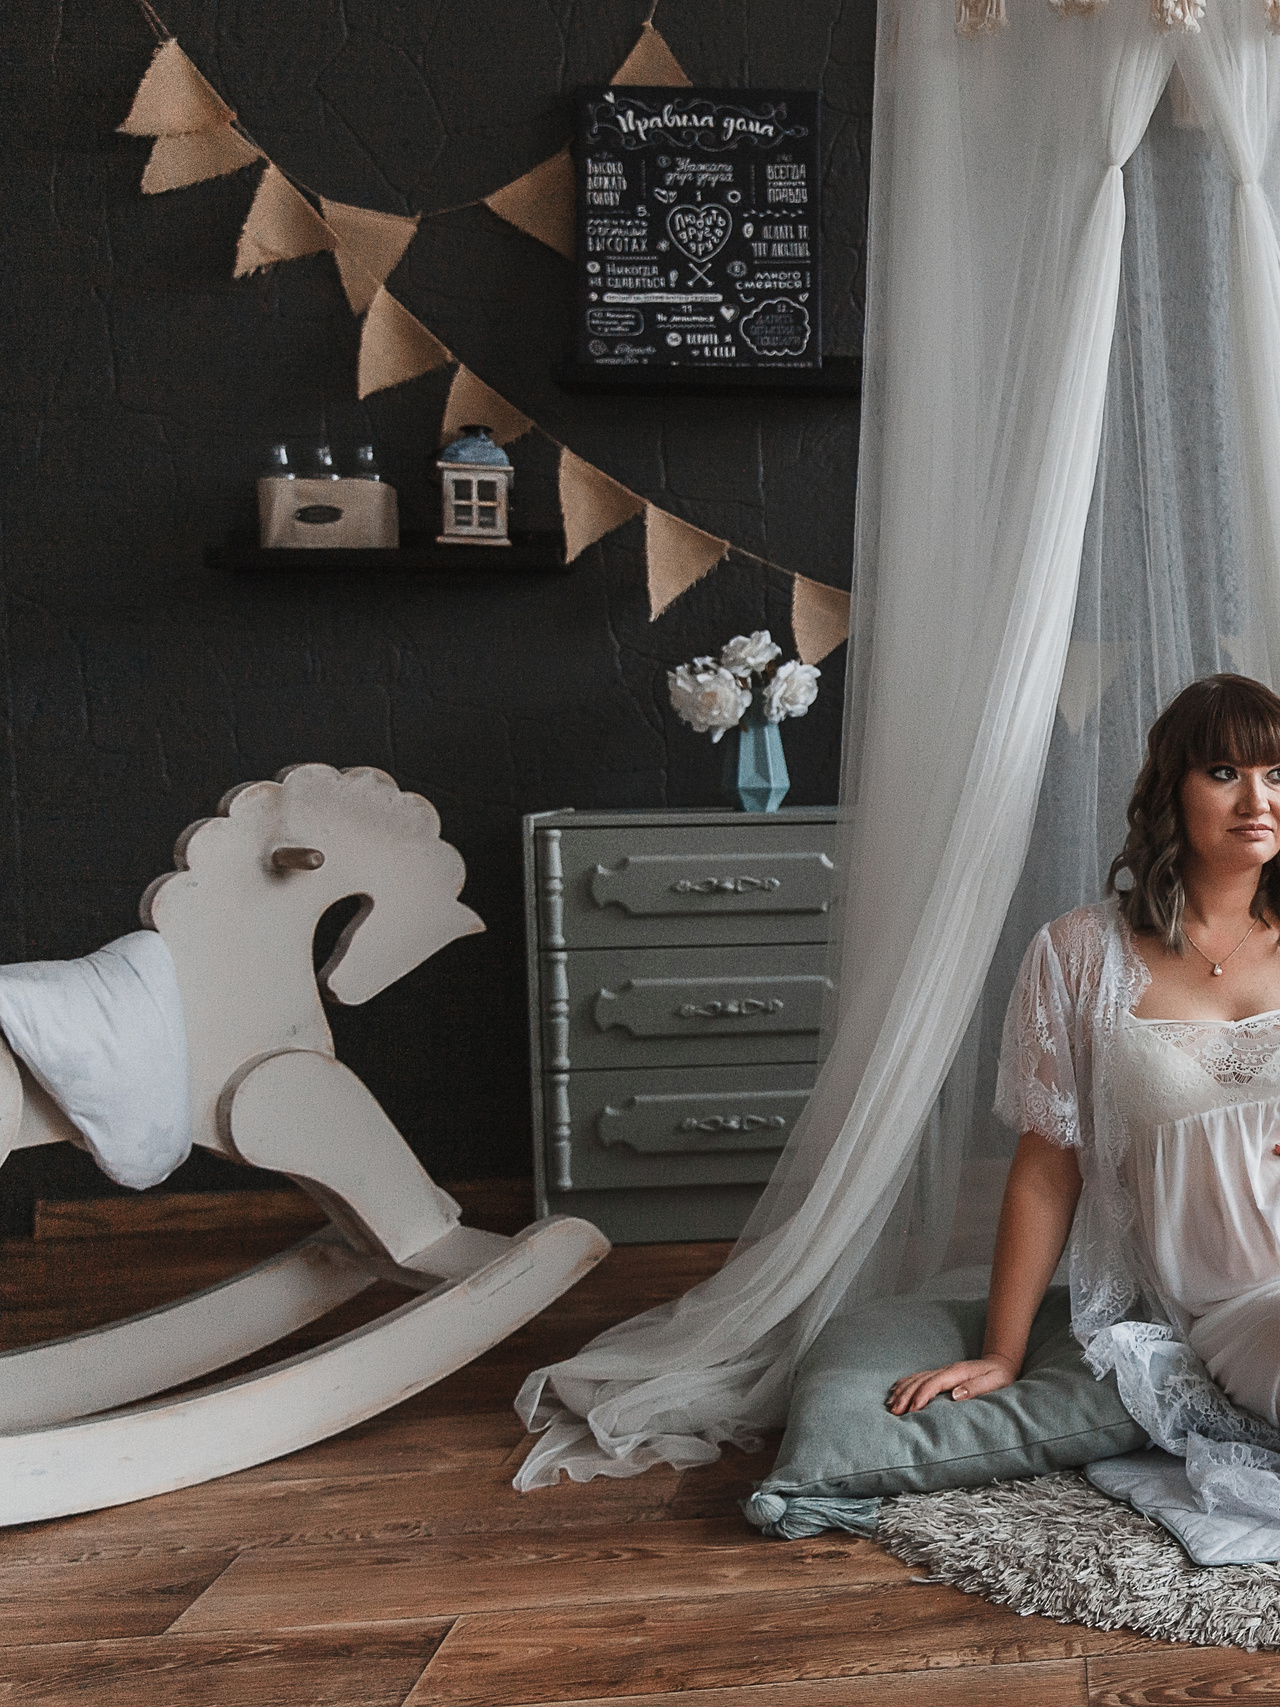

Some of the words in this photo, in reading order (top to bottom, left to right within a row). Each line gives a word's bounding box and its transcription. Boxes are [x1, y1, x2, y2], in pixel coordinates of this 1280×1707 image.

[616, 104, 714, 141] Правила
[722, 117, 774, 141] дома
[766, 164, 806, 180] ВСЕГДА
[767, 188, 808, 203] ПРАВДУ
[587, 236, 649, 252] ВЫСОТАХ
